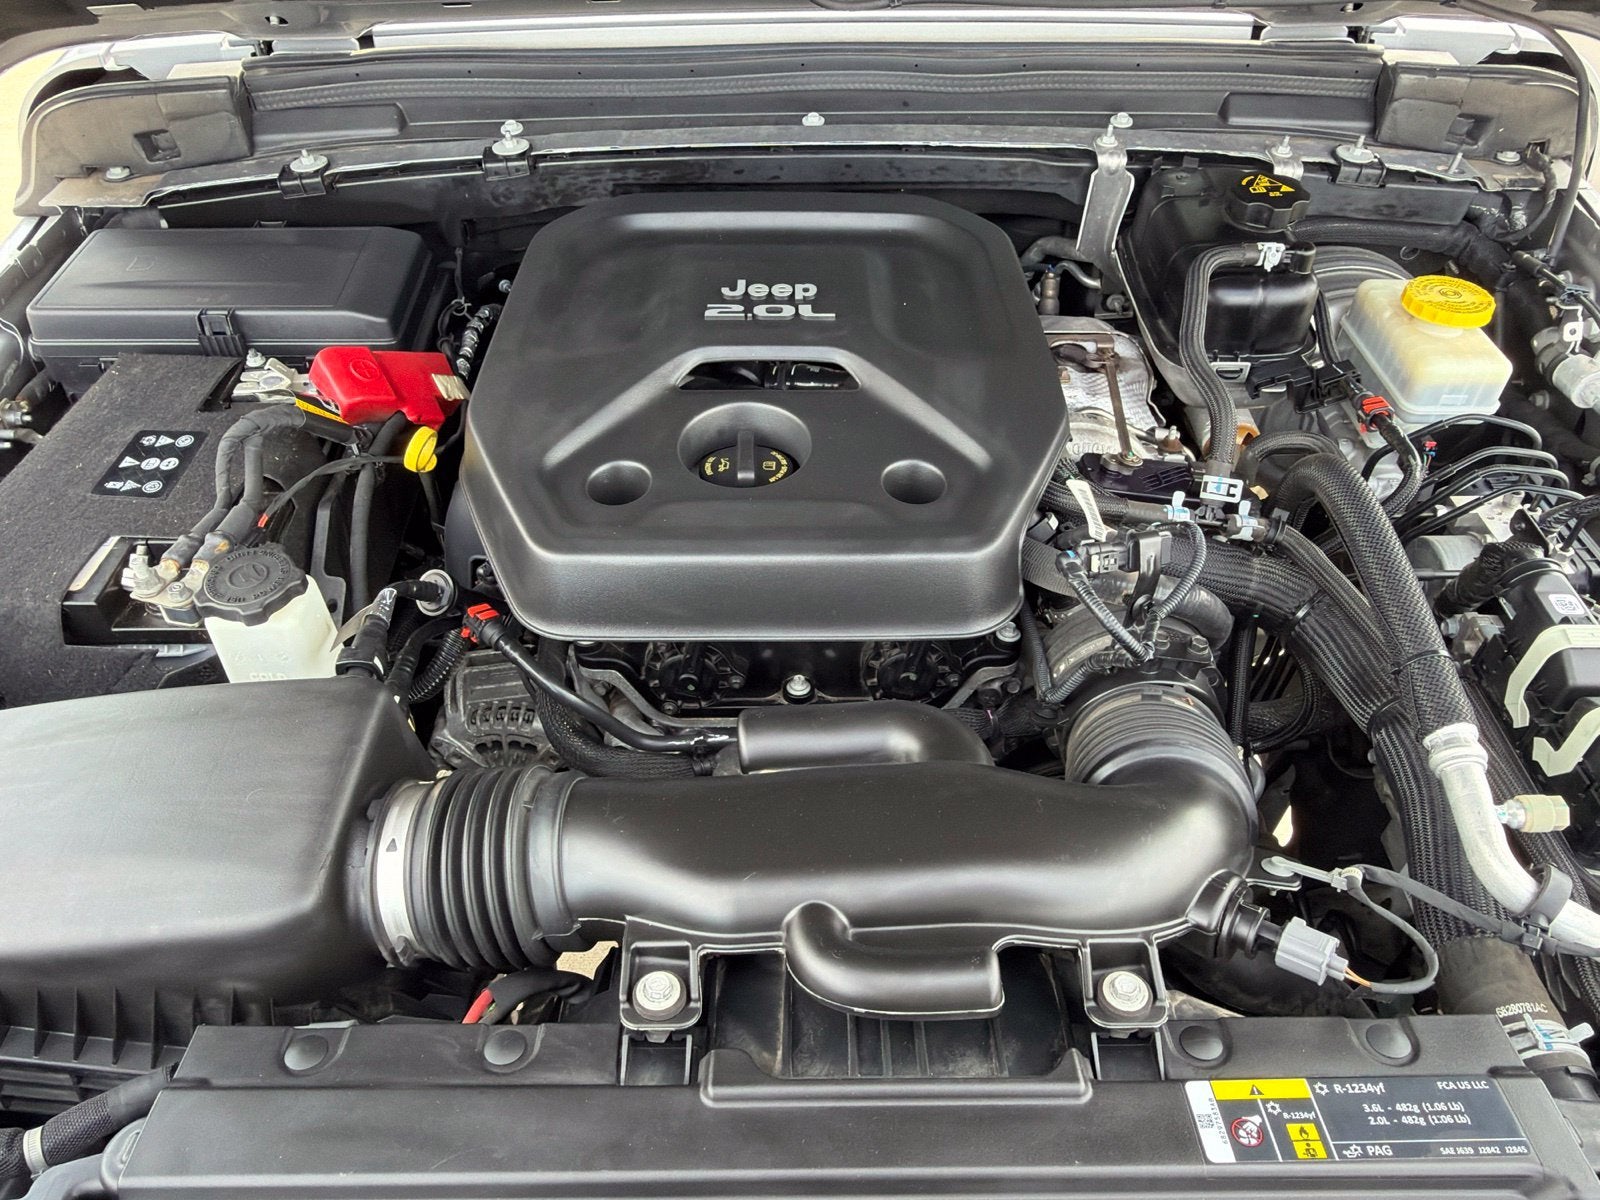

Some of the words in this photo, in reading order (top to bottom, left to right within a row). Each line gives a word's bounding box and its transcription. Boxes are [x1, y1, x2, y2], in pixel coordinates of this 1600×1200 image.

[721, 279, 818, 302] Jeep
[704, 303, 837, 321] 2.0L
[1334, 1082, 1386, 1095] R-1234yf
[1436, 1081, 1456, 1090] FCA
[1456, 1081, 1472, 1090] US
[1472, 1080, 1490, 1089] LLC
[1362, 1103, 1385, 1113] 3.6L
[1396, 1103, 1421, 1113] 482g
[1422, 1102, 1448, 1113] (1.06
[1448, 1101, 1465, 1112] Lb)
[1282, 1111, 1317, 1120] R-1234yf
[1368, 1116, 1391, 1125] 2.0L
[1402, 1115, 1427, 1126] 482g
[1455, 1114, 1472, 1125] Lb)
[1367, 1145, 1393, 1157] PAG
[1440, 1147, 1456, 1155] SAE
